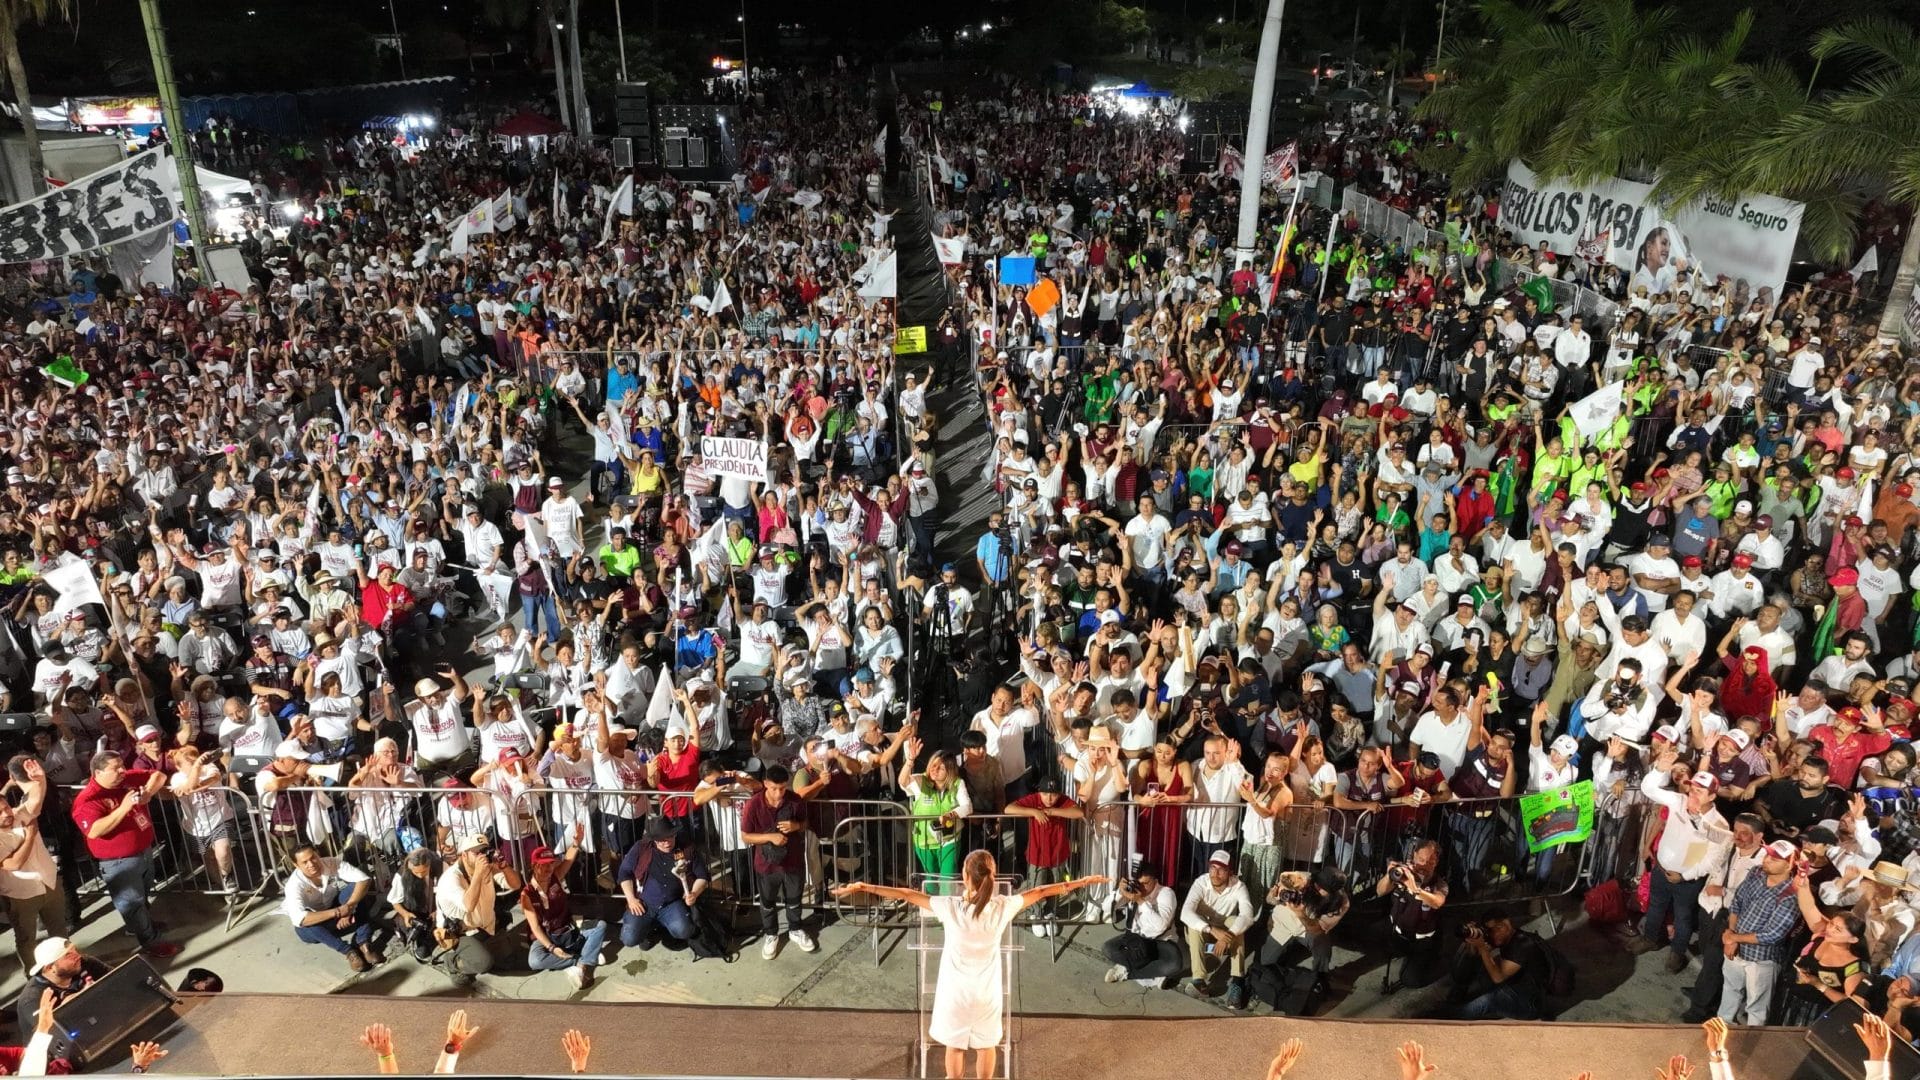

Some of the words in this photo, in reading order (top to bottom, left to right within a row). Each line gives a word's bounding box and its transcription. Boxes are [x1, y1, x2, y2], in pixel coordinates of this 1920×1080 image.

[1533, 191, 1583, 235] LOS
[1703, 197, 1737, 217] Salud
[1738, 202, 1788, 231] Seguro
[703, 438, 764, 462] CLAUDIA
[704, 459, 764, 477] PRESIDENTA.
[1352, 569, 1360, 579] H
